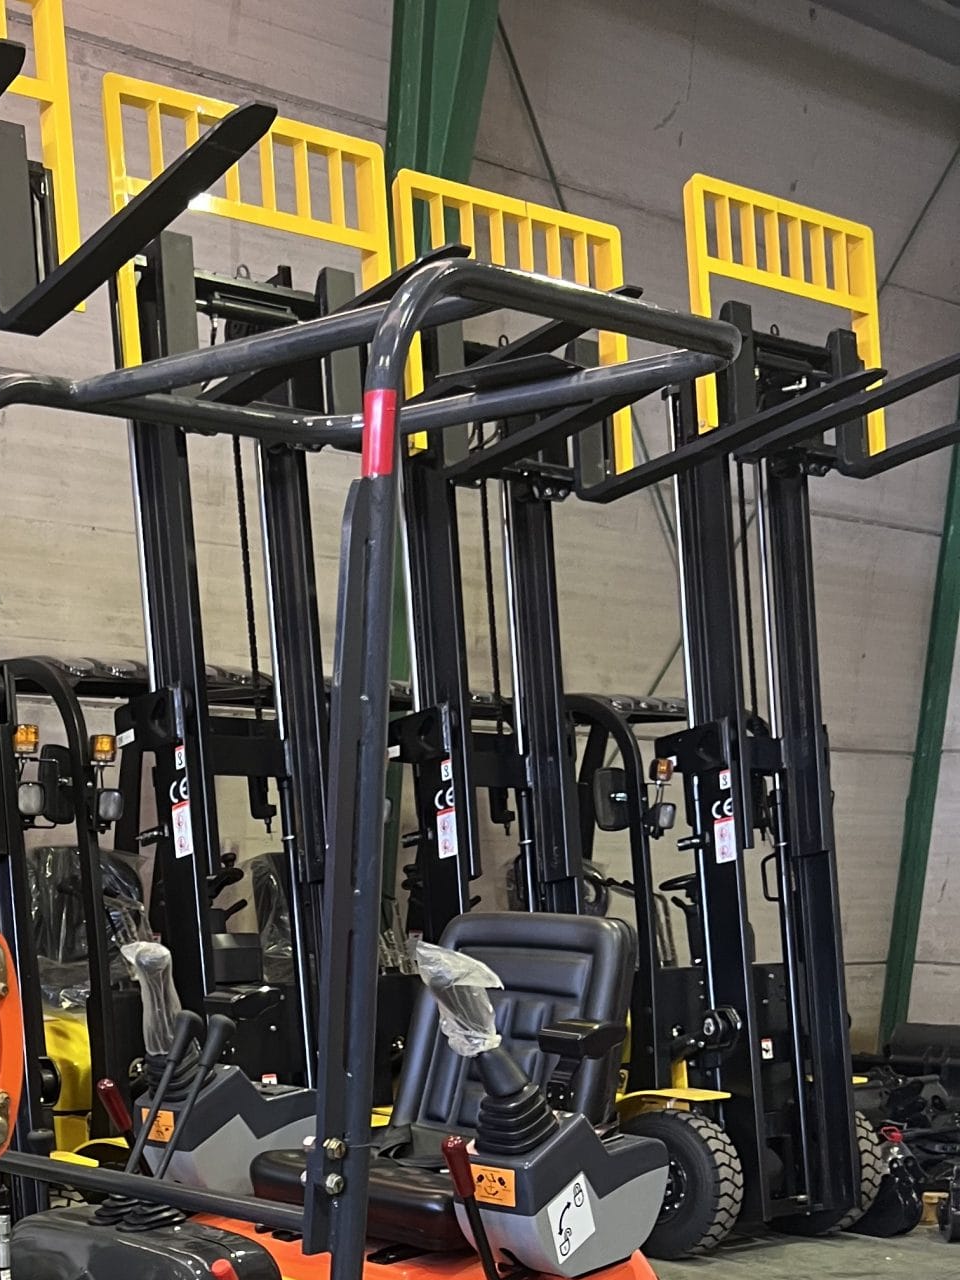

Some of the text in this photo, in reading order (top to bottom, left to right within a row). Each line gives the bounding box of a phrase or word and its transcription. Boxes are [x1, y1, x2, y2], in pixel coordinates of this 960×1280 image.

[169, 776, 189, 803] CE
[434, 786, 455, 810] CE
[711, 797, 733, 819] CE
